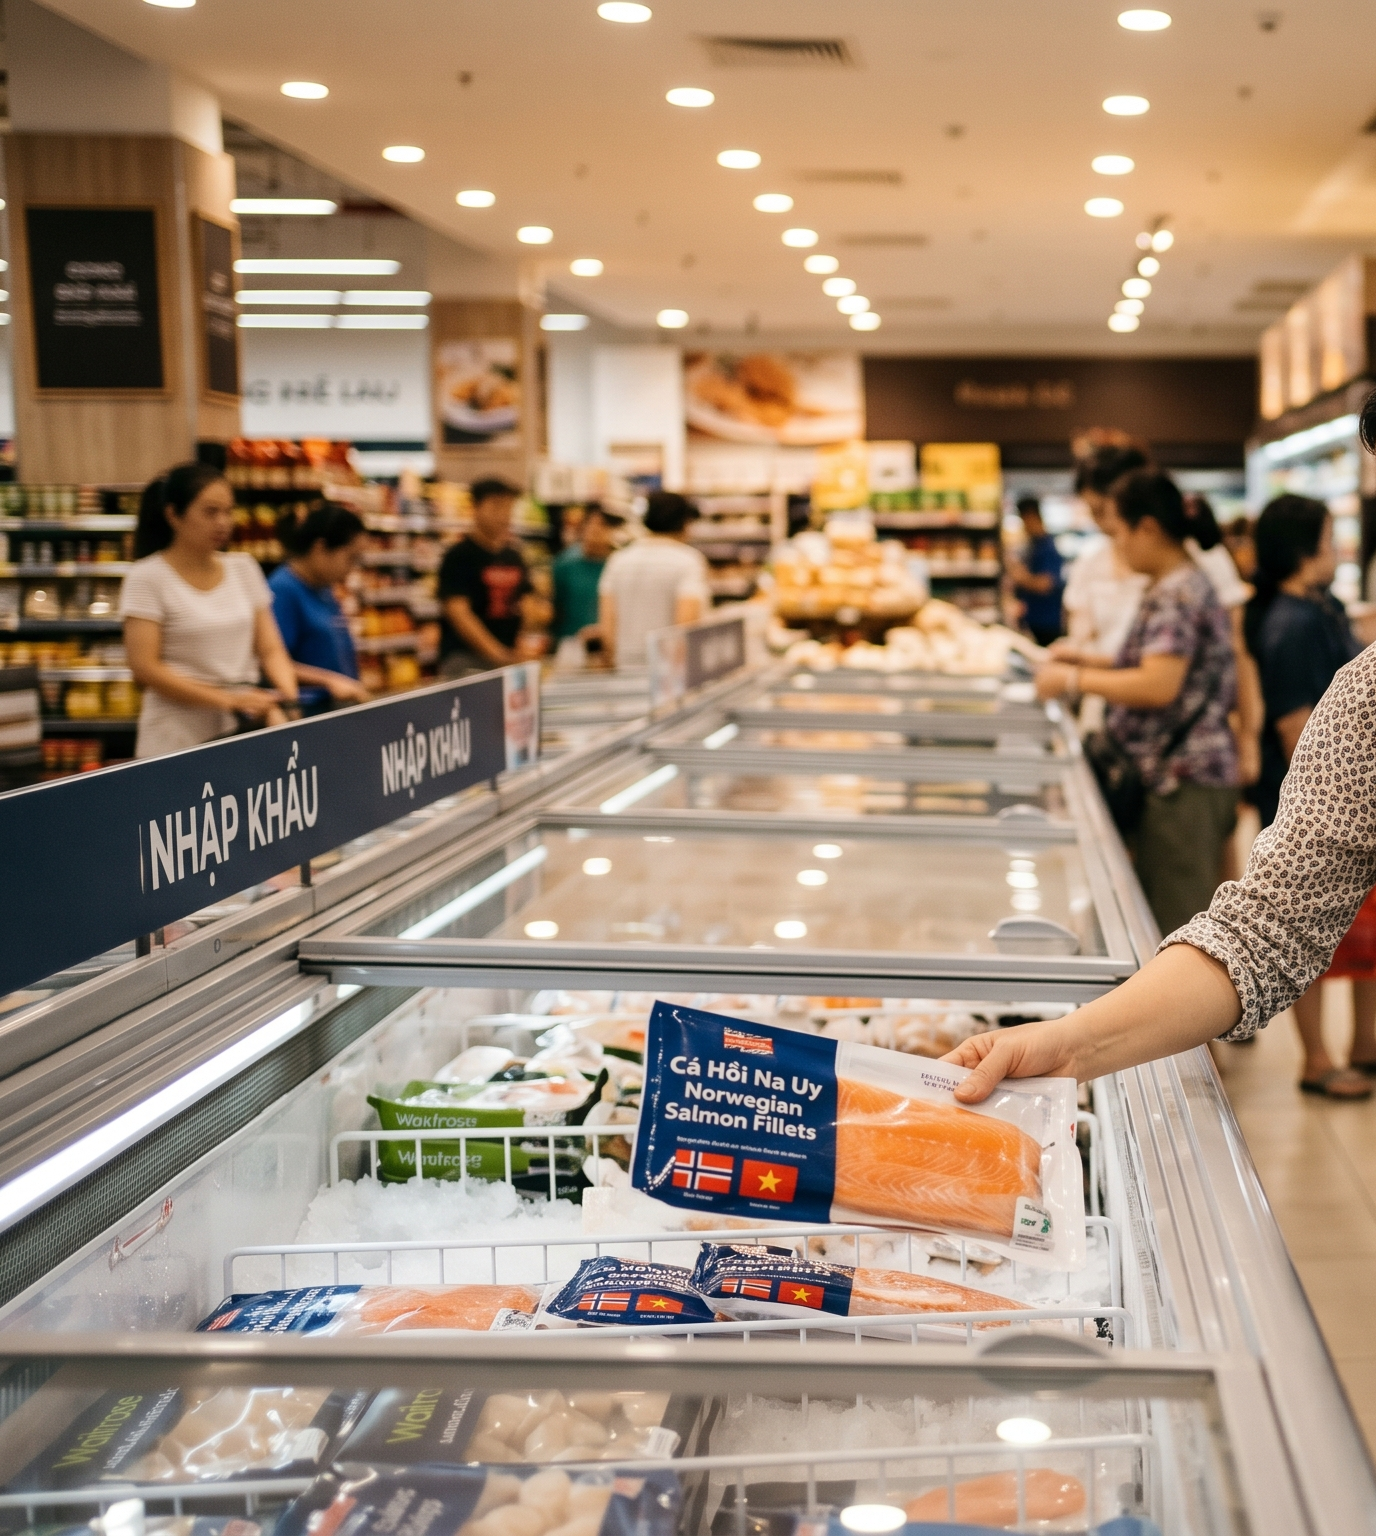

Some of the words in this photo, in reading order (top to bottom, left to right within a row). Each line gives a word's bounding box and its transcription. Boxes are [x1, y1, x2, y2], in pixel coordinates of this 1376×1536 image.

[381, 722, 427, 799] NHẬP
[429, 697, 472, 778] KHẨU
[149, 781, 239, 890] NHẬP
[247, 740, 319, 852] KHẨU
[670, 1056, 701, 1077] Cá
[707, 1060, 748, 1084] Hồi
[753, 1069, 785, 1091] Na
[791, 1076, 823, 1101] Uy
[684, 1081, 803, 1117] Norwegian
[664, 1102, 748, 1130] Salmon
[753, 1115, 817, 1141] Fillets
[52, 1395, 144, 1469] Waitrose
[386, 1388, 444, 1444] Waitro
